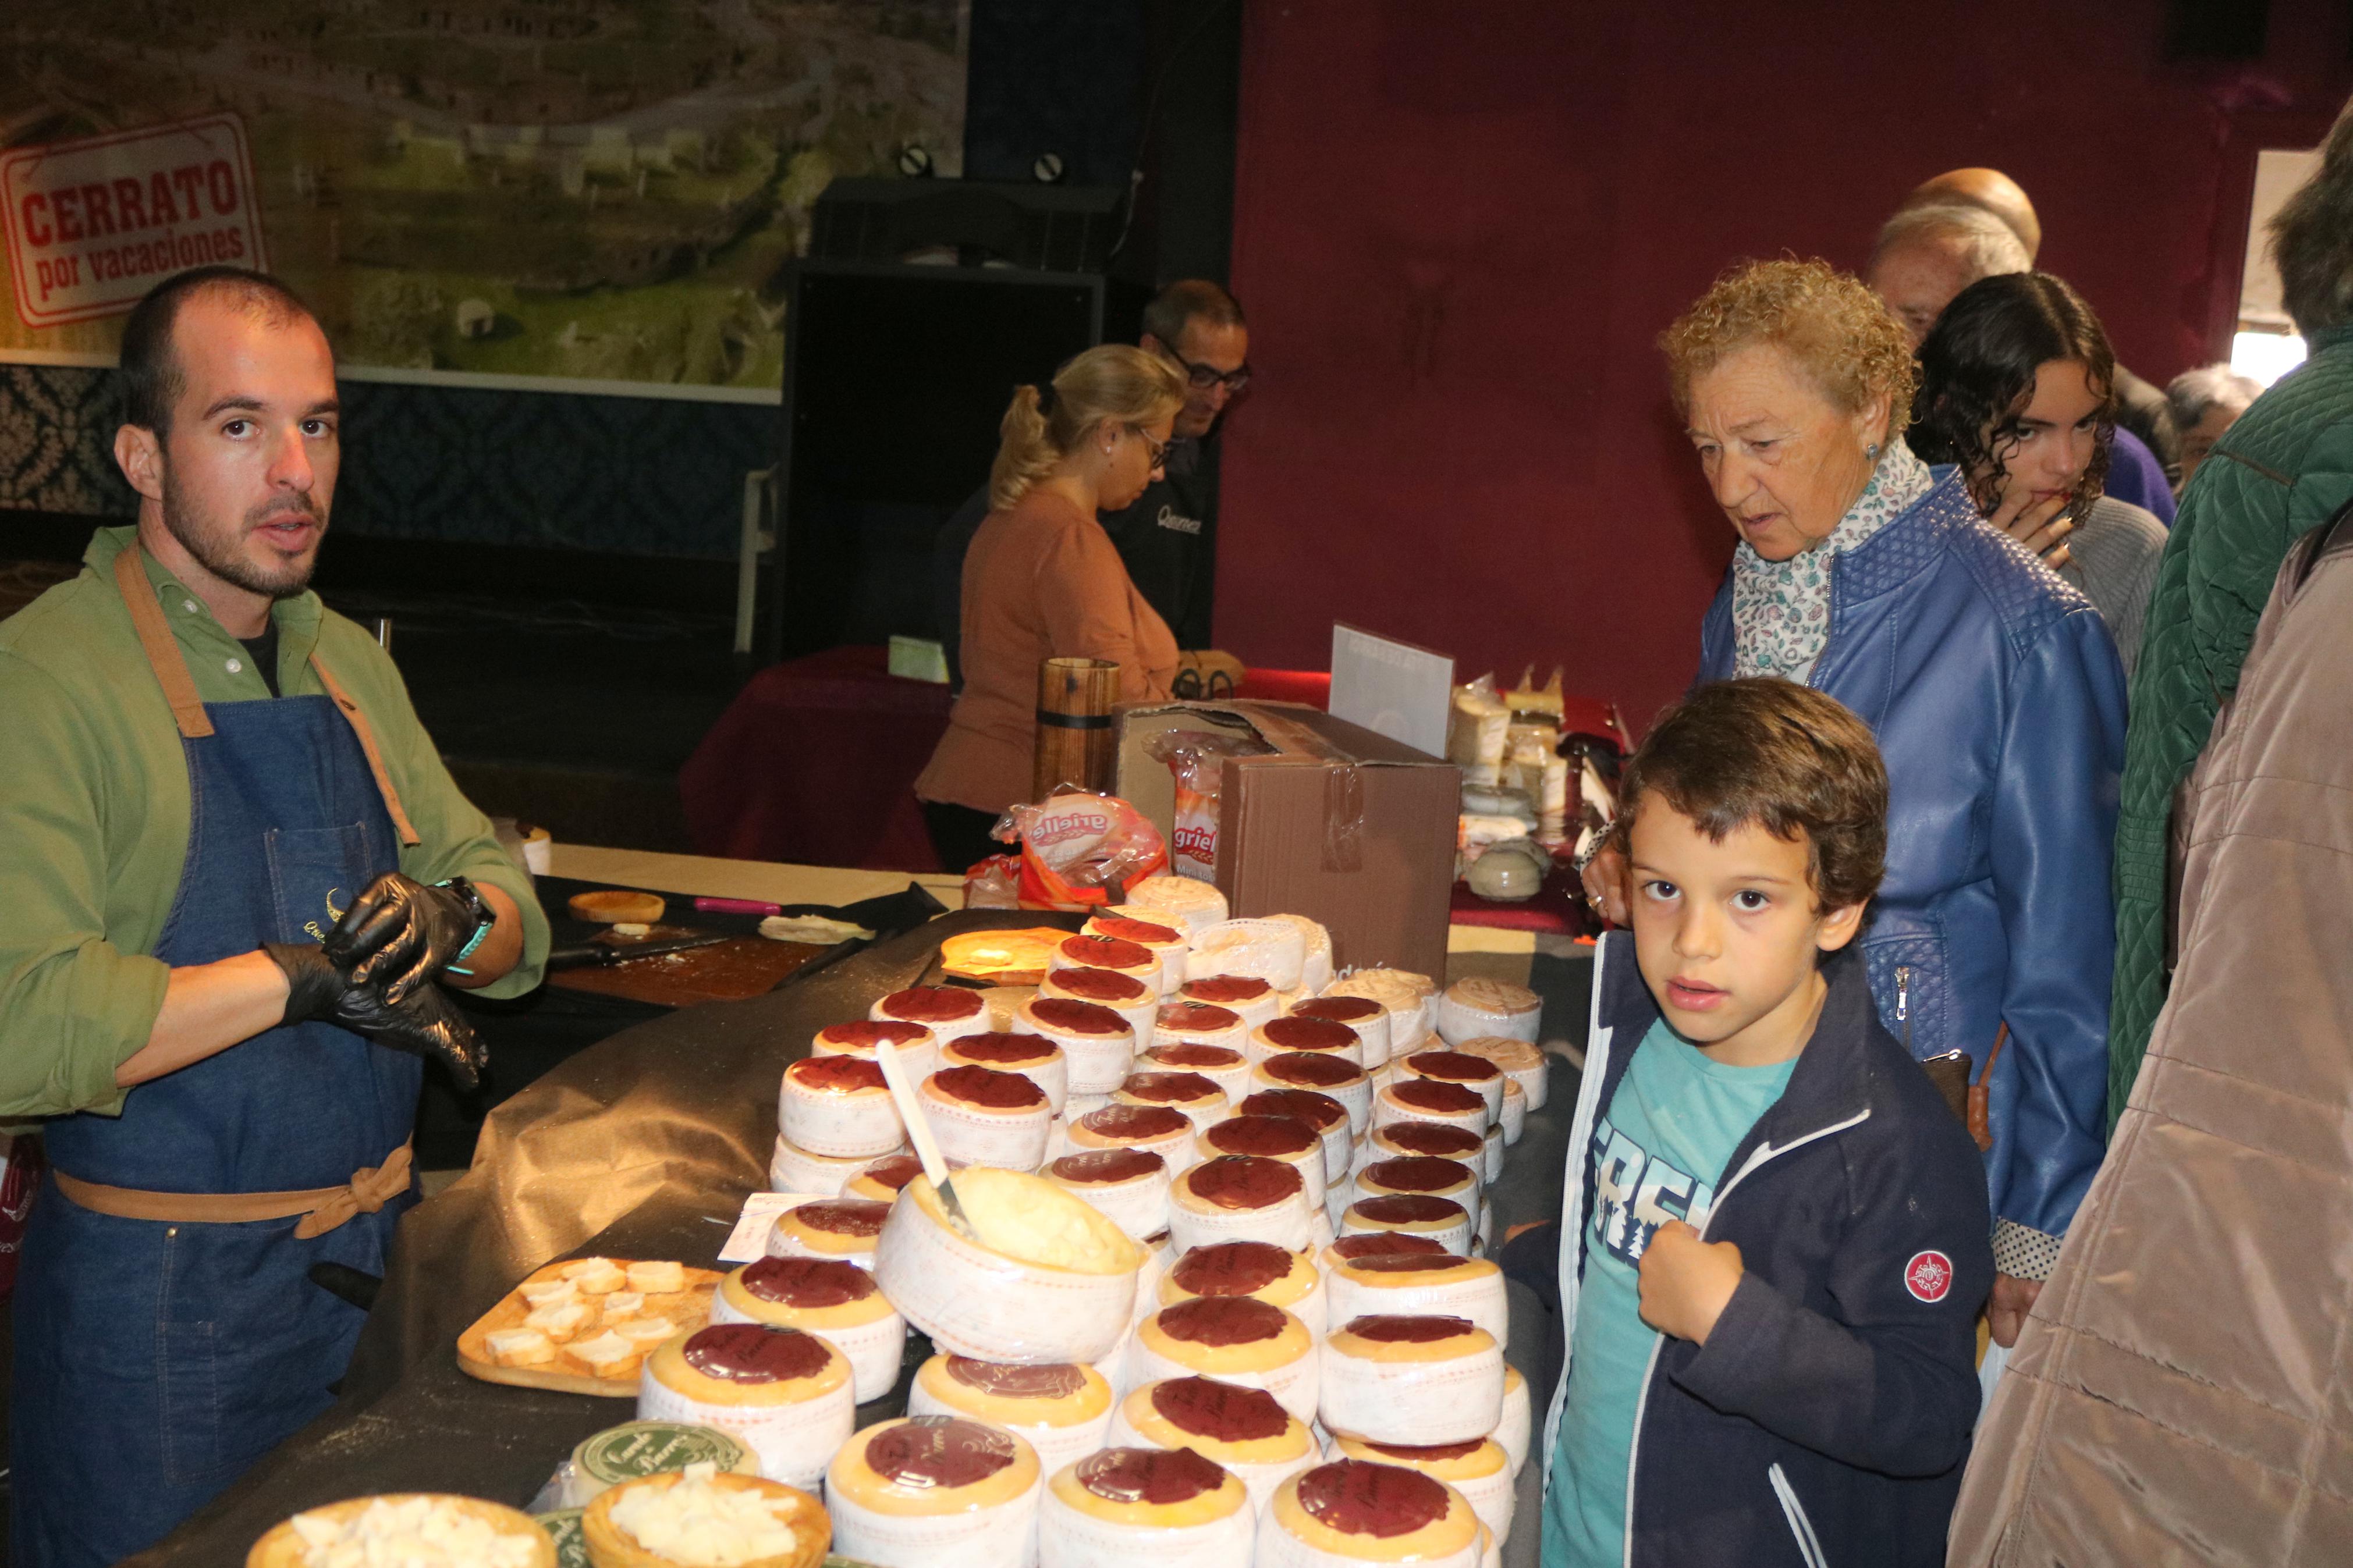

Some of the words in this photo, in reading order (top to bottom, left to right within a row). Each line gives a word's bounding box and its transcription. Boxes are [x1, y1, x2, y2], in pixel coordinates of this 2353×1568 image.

[21, 159, 239, 248] CERRATO
[36, 254, 80, 303] por
[87, 226, 244, 282] vacaciones
